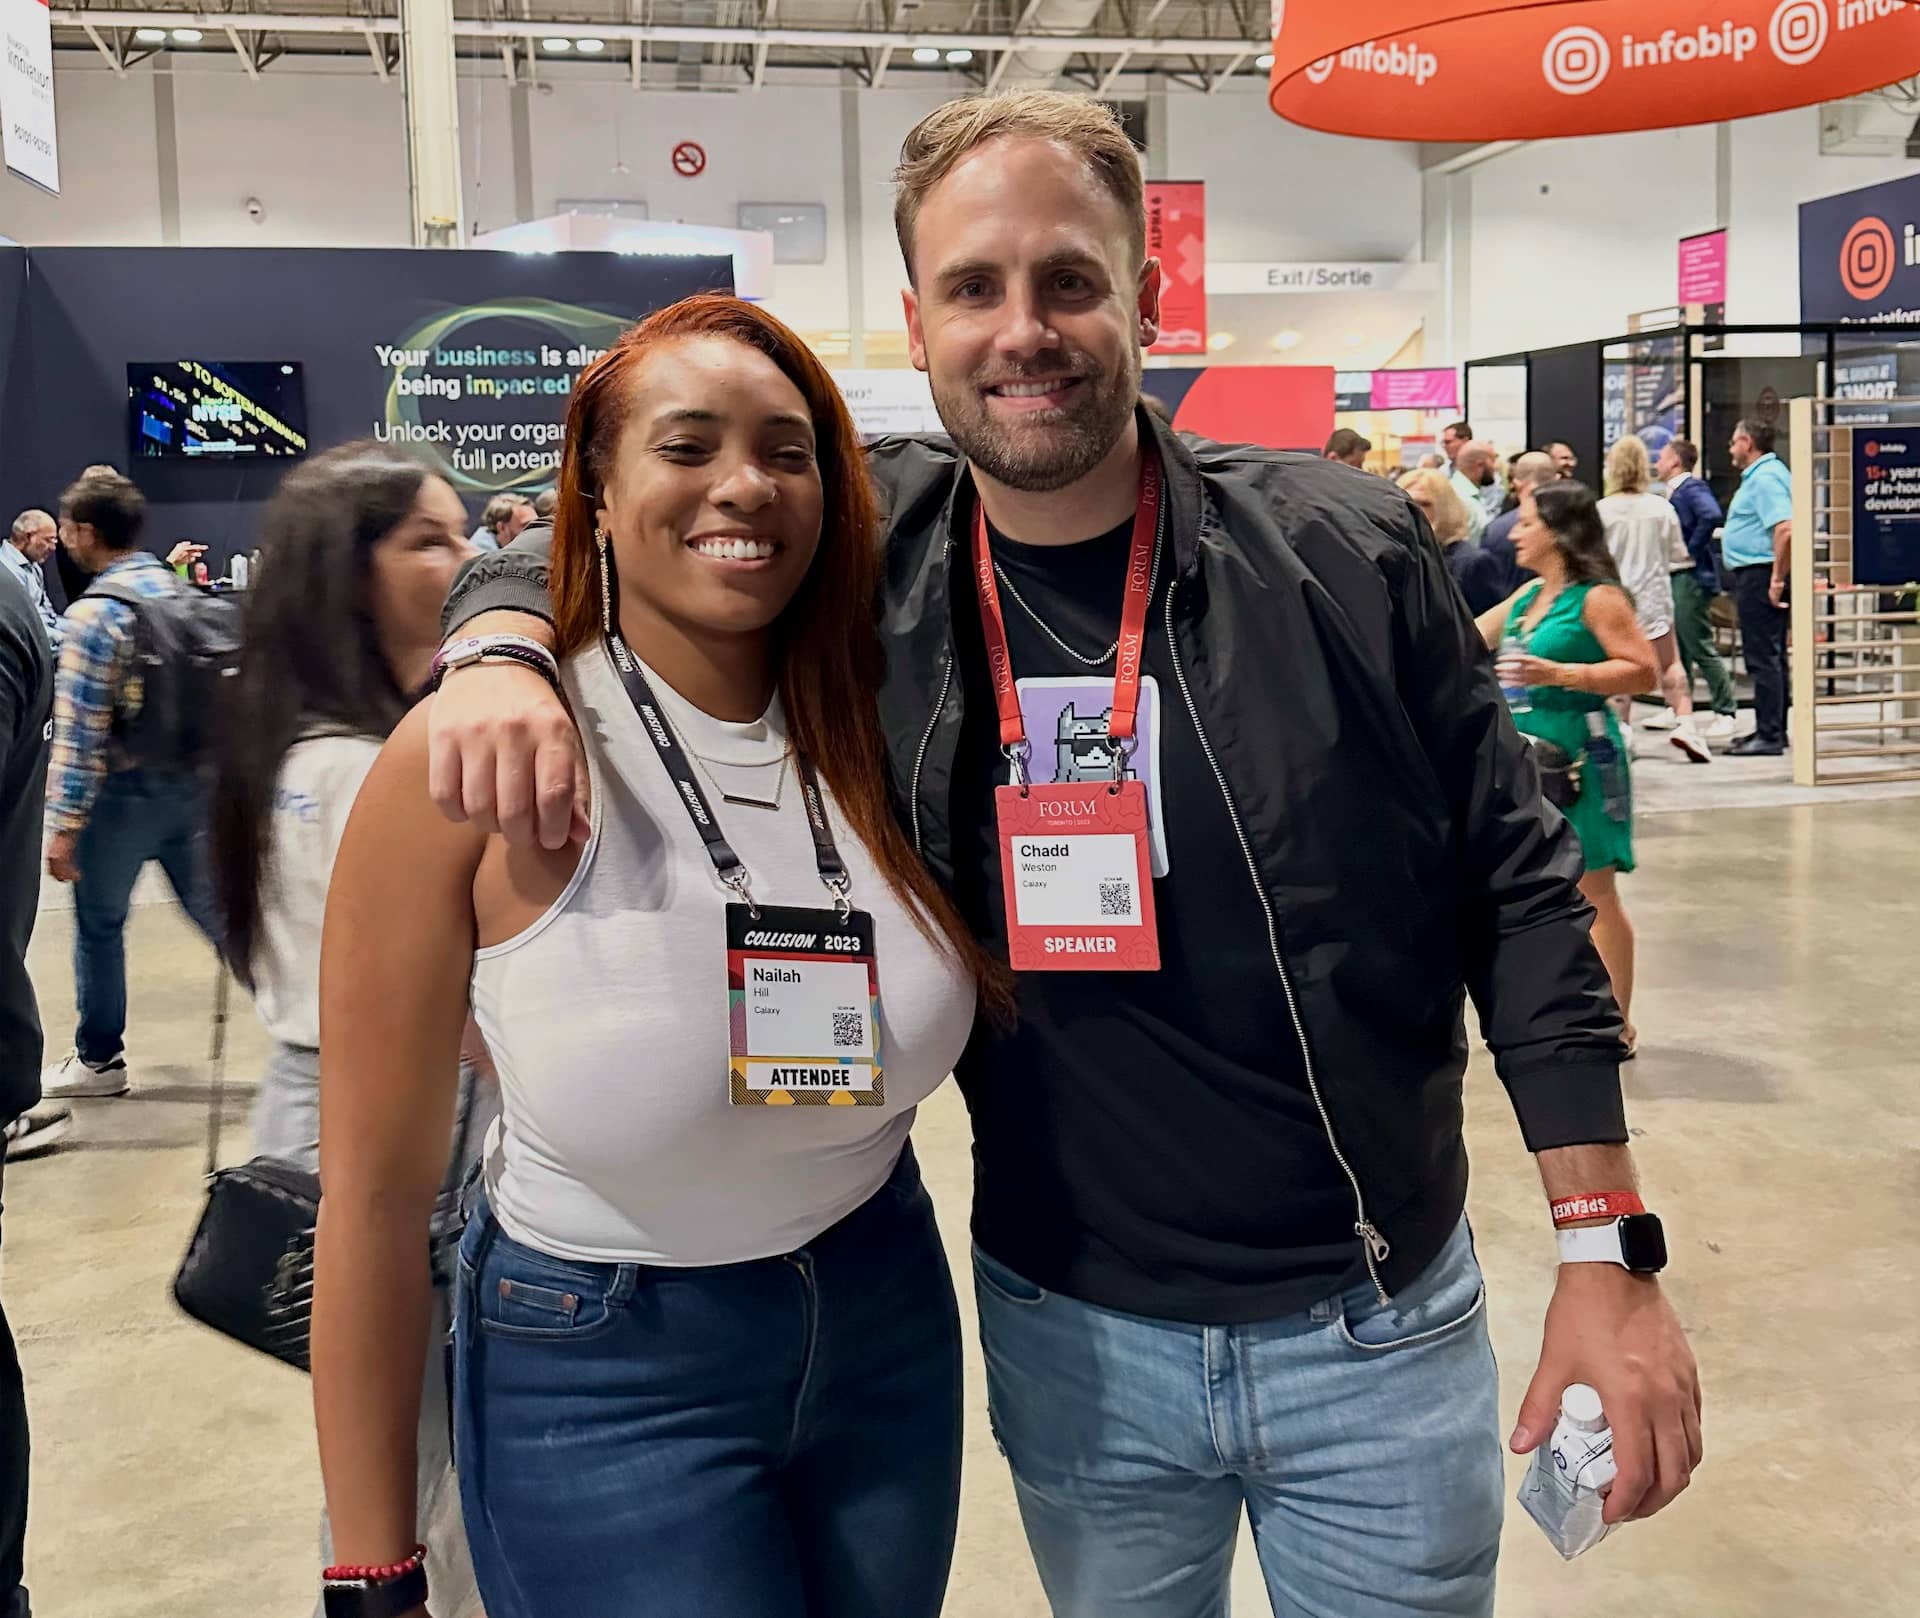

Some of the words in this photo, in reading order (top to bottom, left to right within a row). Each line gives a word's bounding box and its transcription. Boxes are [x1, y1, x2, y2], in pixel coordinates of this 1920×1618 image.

[1621, 21, 1757, 68] infobip
[1151, 208, 1162, 249] ALPHA
[375, 345, 429, 367] Your
[435, 345, 536, 366] business
[541, 345, 561, 366] is
[397, 373, 461, 400] being
[466, 374, 571, 399] impacted
[192, 403, 243, 422] NYSE
[374, 420, 452, 442] Unlock
[455, 424, 505, 446] your
[452, 448, 486, 470] full
[1866, 465, 1887, 479] 15+
[1864, 481, 1879, 495] of
[1130, 544, 1150, 593] FORUM
[977, 558, 996, 607] FORUM
[610, 634, 633, 673] COLLISION
[1120, 632, 1139, 685] FORUM
[991, 644, 1010, 694] FORUM
[640, 703, 671, 748] COLLISION
[679, 780, 710, 825] COLLISION
[1039, 800, 1097, 817] FORUM
[1020, 844, 1070, 858] Chadd
[1021, 863, 1057, 872] Weston
[743, 930, 817, 949] COLLISION
[823, 935, 861, 952] 2023
[1044, 937, 1117, 953] SPEAKER
[753, 967, 801, 983] Nailah
[753, 987, 769, 997] Hill
[771, 1068, 850, 1086] ATTENDEE
[1552, 1198, 1608, 1219] SPEAKER
